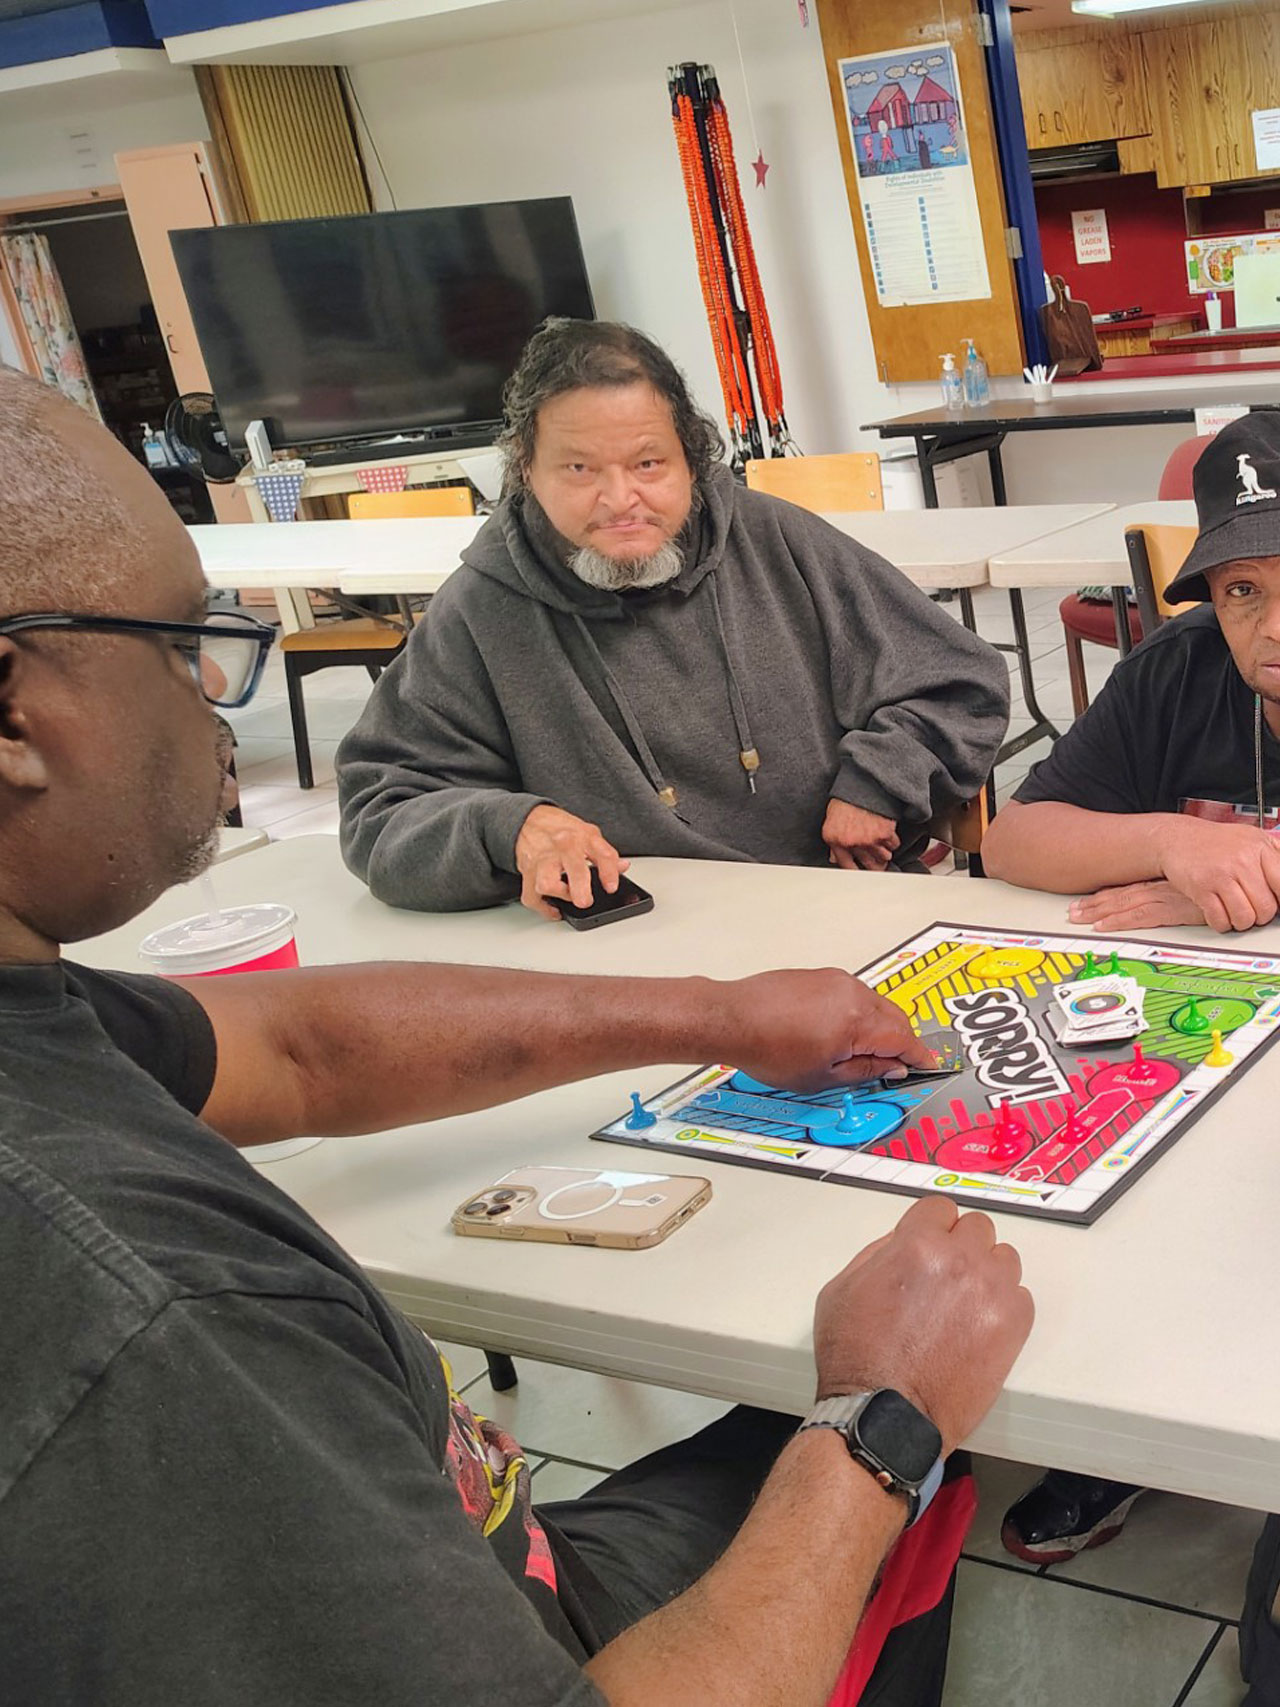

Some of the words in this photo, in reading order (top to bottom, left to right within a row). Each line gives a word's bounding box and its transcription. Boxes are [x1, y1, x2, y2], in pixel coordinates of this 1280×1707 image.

[1078, 226, 1102, 234] GREASE
[1080, 248, 1106, 257] VAPORS
[951, 990, 1067, 1105] SORRY!
